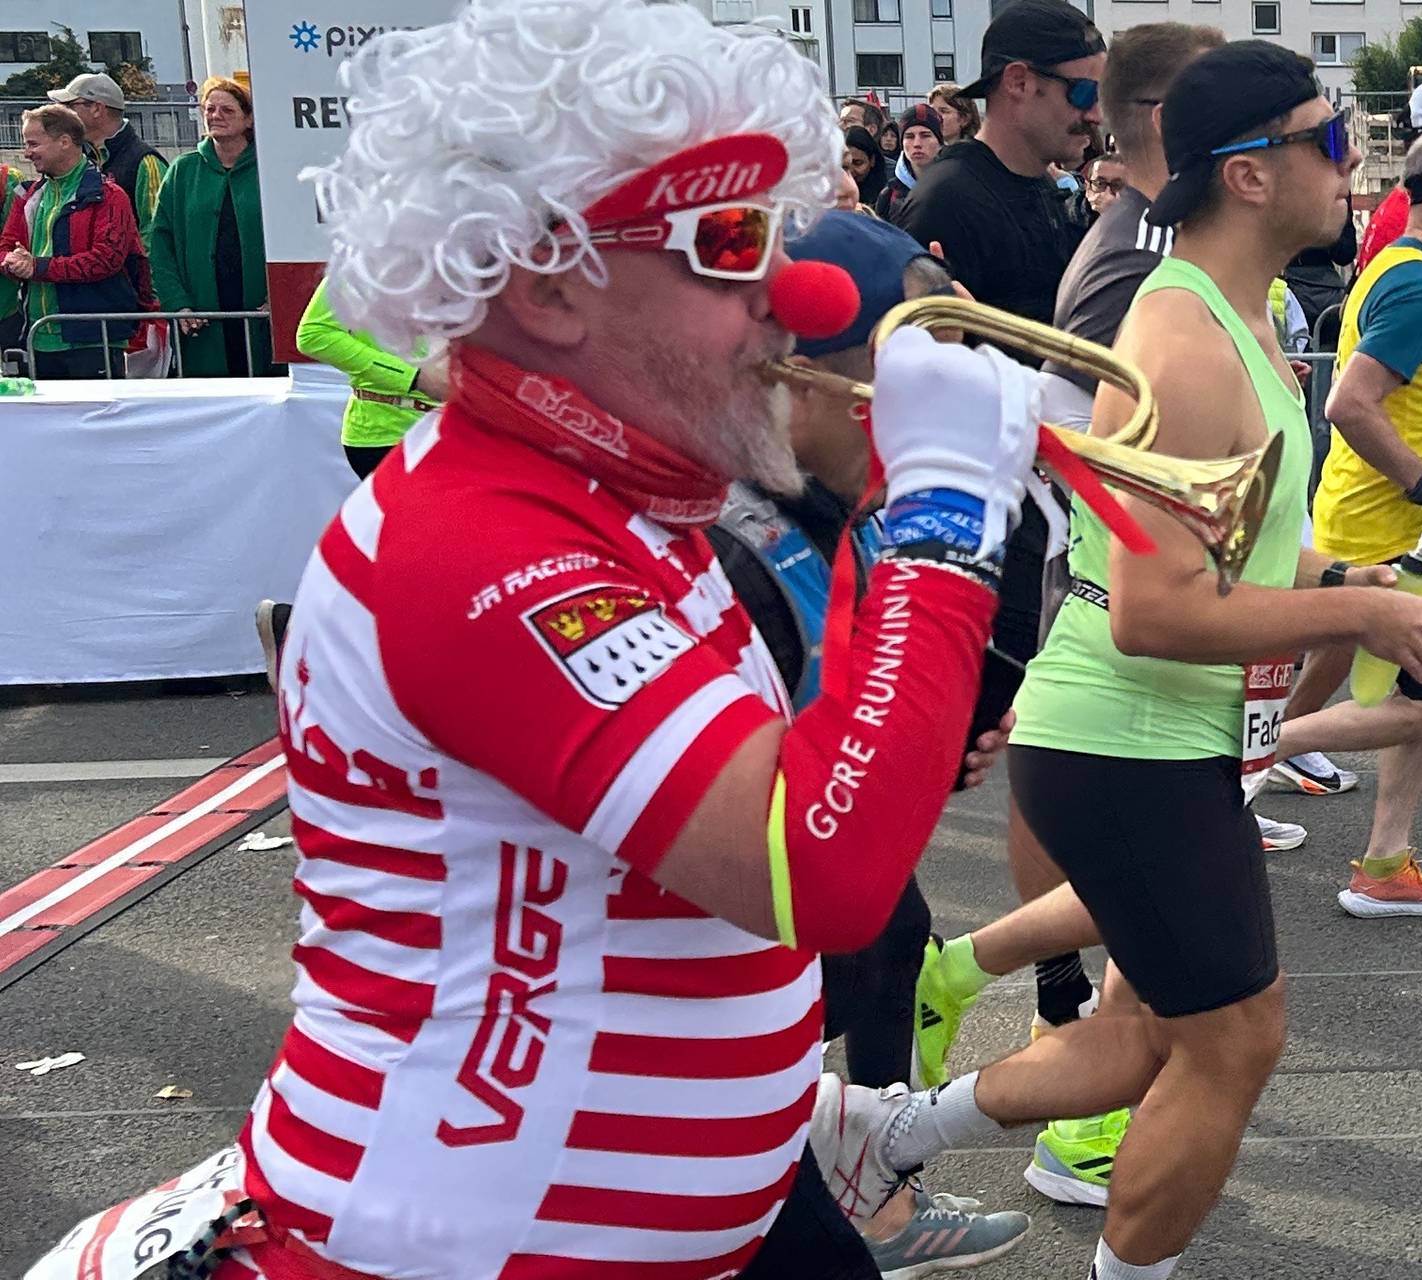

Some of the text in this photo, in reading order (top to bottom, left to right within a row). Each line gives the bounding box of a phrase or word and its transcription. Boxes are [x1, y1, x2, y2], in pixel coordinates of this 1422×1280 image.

[645, 160, 763, 209] Köln
[805, 735, 877, 840] GORE
[435, 840, 569, 1149] VERGE
